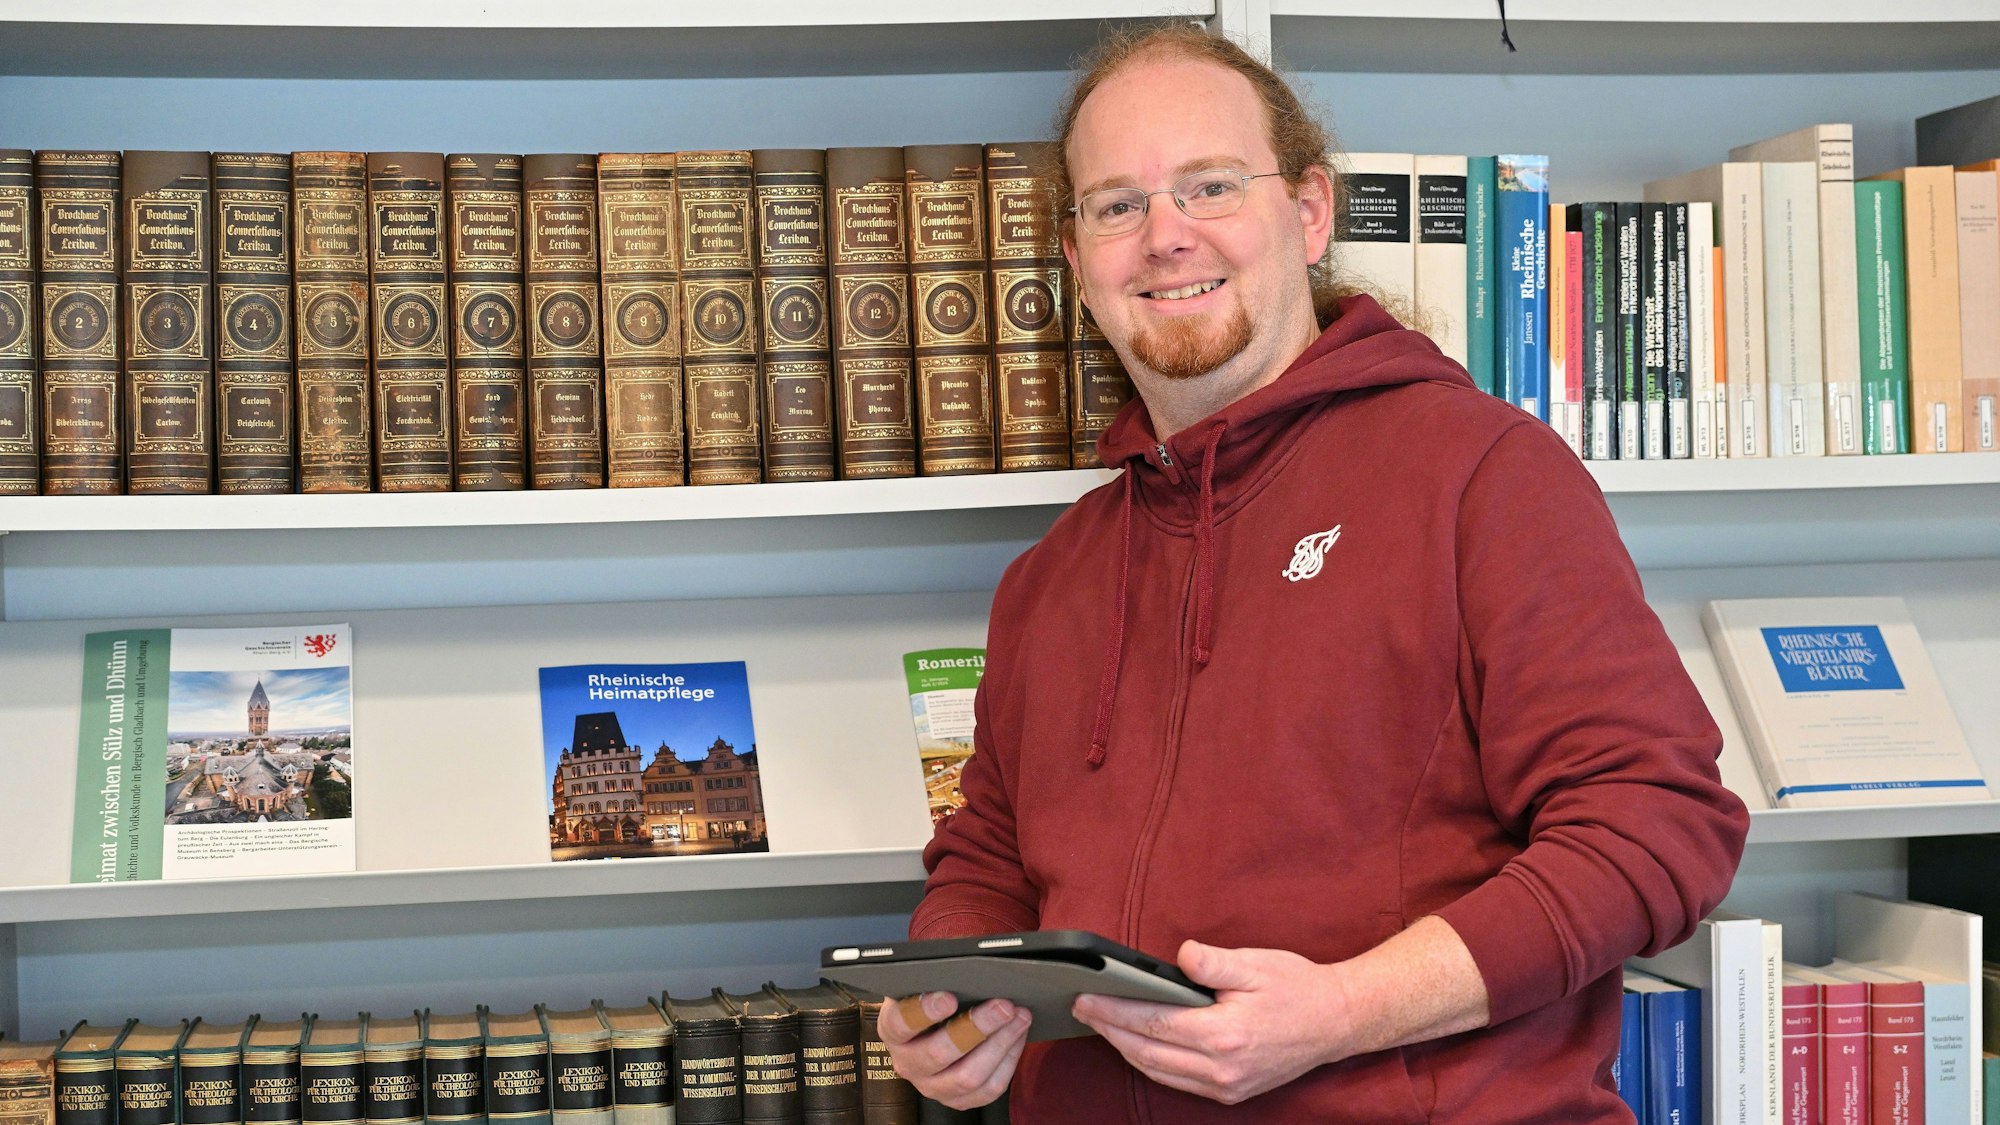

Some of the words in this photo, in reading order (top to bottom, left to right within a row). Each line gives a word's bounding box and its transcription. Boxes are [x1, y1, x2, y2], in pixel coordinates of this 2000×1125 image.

[1676, 206, 1685, 225] 1945
[778, 233, 811, 245] Lexikon.
[932, 229, 965, 241] Lexikon.
[1594, 210, 1605, 265] Landeskunde
[1619, 226, 1629, 258] Wahlen
[1677, 231, 1686, 250] 1933
[151, 238, 186, 250] Lexikon.
[237, 239, 273, 252] Lexikon.
[392, 238, 427, 251] Lexikon.
[1475, 244, 1485, 281] Rheinische
[1512, 247, 1520, 271] Kleine
[1520, 219, 1535, 299] Rheinische
[1535, 229, 1546, 290] Geschichte
[1629, 217, 1638, 305] Nordrhein-Westfalen
[1654, 211, 1664, 312] Nordrhein-Westfalen
[1619, 260, 1629, 277] und
[1677, 251, 1686, 292] Westfalen
[1595, 265, 1605, 307] politische
[1668, 261, 1678, 308] Widerstand
[1619, 279, 1629, 315] Parteien
[1877, 295, 1885, 309] der
[870, 308, 881, 319] 12
[946, 305, 957, 316] 13
[1025, 302, 1036, 313] 14
[1594, 307, 1604, 323] Eine
[1629, 306, 1638, 314] in
[1677, 302, 1686, 319] und
[75, 317, 83, 329] 2
[164, 317, 172, 329] 3
[249, 318, 258, 331] 4
[330, 317, 337, 328] 5
[407, 317, 415, 328] 6
[487, 317, 495, 328] 7
[562, 316, 570, 327] 8
[640, 316, 647, 327] 9
[715, 313, 726, 325] 10
[792, 311, 802, 322] 11
[1645, 296, 1655, 349] Wirtschaft
[1668, 309, 1678, 326] und
[1523, 312, 1535, 345] Janssen
[1654, 313, 1664, 348] Landes
[1677, 319, 1686, 360] Rheinland
[1654, 349, 1664, 367] des
[1668, 327, 1678, 373] Verfolgung
[1645, 350, 1655, 367] Die
[1879, 359, 1887, 370] Die
[1677, 361, 1686, 373] im
[1778, 632, 1867, 650] RHEINISCHE
[105, 639, 127, 690] Dhünn
[135, 639, 149, 680] Umgebung
[587, 673, 685, 687] Rheinische
[134, 682, 146, 698] und
[590, 686, 715, 702] Heimatpflege
[104, 694, 125, 724] und
[133, 699, 145, 735] Gladbach
[102, 727, 124, 761] Sülz
[131, 737, 144, 771] Bergisch
[131, 773, 141, 783] in
[100, 764, 121, 837] zwischen
[128, 784, 141, 832] Volkskunde
[128, 834, 140, 851] und
[96, 842, 117, 885] eimat
[1767, 956, 1775, 1040] BUNDESREPUBLIK
[1738, 968, 1746, 1074] NORDRHEIN-WESTFALEN
[1786, 1017, 1800, 1025] Band
[744, 1052, 796, 1066] HANDWÖRTERBUCH
[1768, 1042, 1776, 1062] DER
[563, 1066, 604, 1077] LEXIKON
[681, 1057, 735, 1070] HANDWÖRTERBUCH
[571, 1074, 608, 1084] THEOLOGIE
[684, 1074, 697, 1084] DER
[699, 1072, 737, 1083] KOMMUNAL-
[746, 1070, 759, 1080] DER
[761, 1069, 798, 1080] KOMMUNAL-
[124, 1083, 166, 1093] LEXIKON
[189, 1080, 233, 1090] LEXIKON
[198, 1088, 238, 1097] THEOLOGIE
[562, 1083, 578, 1093] UND
[579, 1082, 606, 1091] KIRCHE
[1768, 1063, 1777, 1116] KERNLAND
[1800, 1067, 1808, 1105] Gegenwart
[1850, 1066, 1860, 1105] Gegenwart
[133, 1090, 172, 1100] THEOLOGIE
[189, 1097, 205, 1106] UND
[206, 1097, 233, 1105] KIRCHE
[124, 1100, 140, 1109] UND
[141, 1099, 167, 1108] KIRCHE
